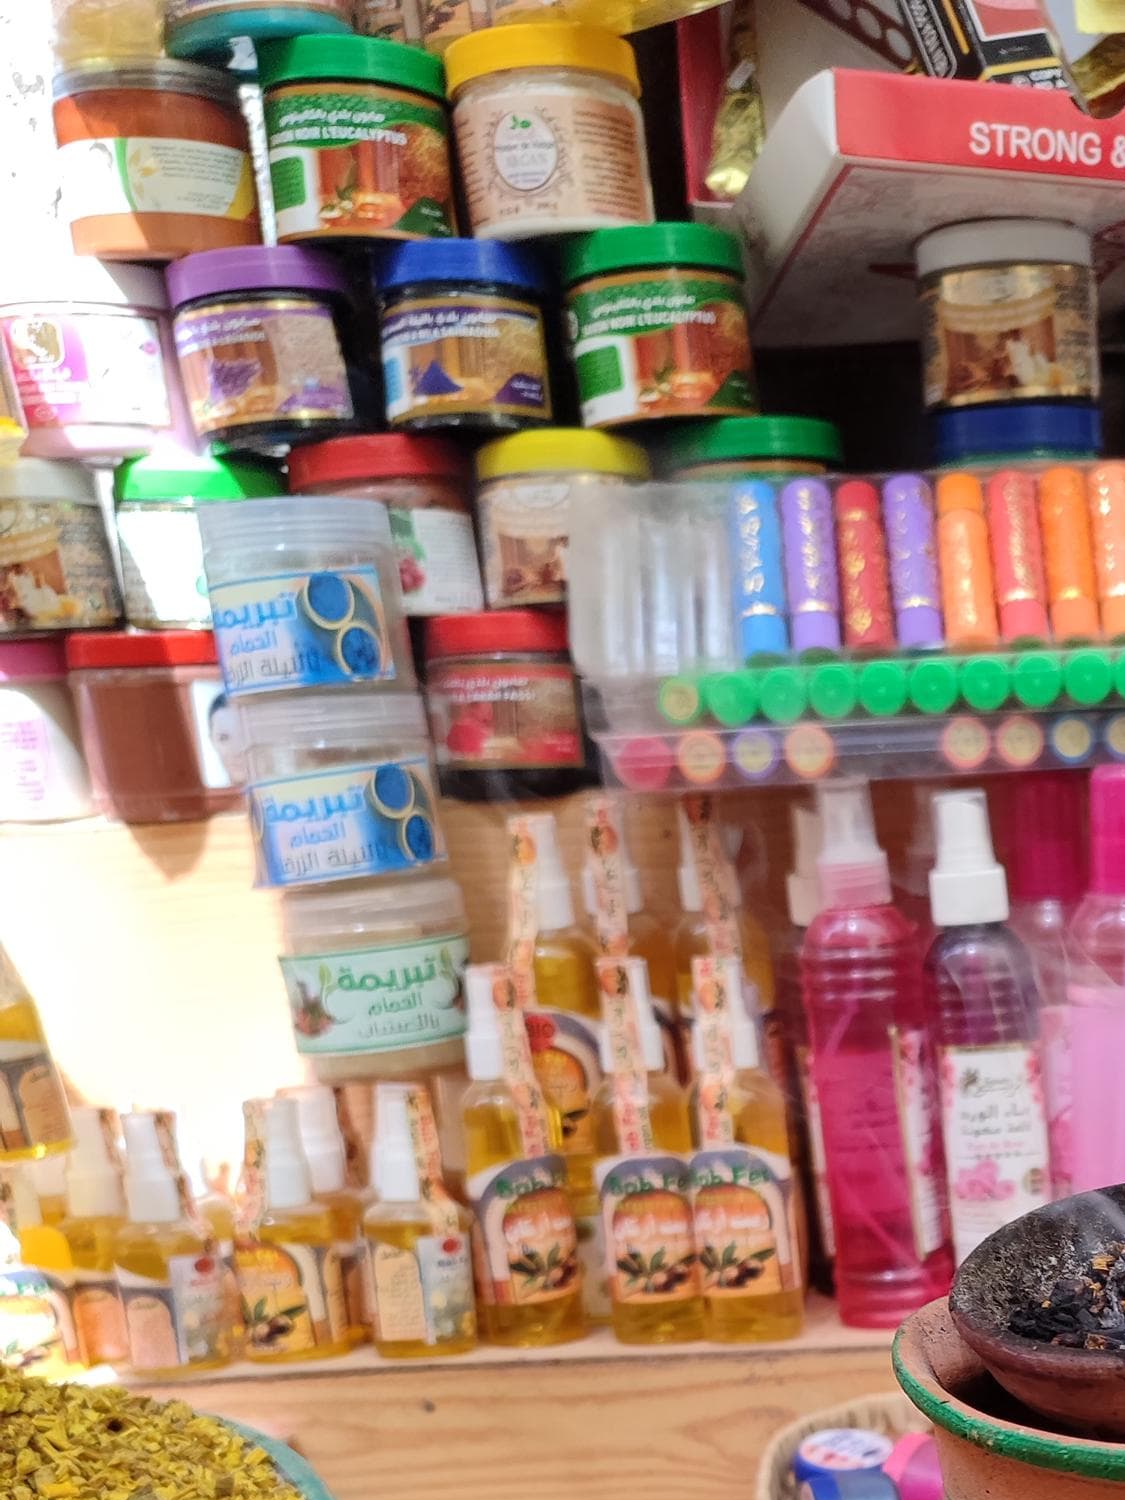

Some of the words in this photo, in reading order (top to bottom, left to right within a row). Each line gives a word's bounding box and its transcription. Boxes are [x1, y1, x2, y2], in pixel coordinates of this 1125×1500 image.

[969, 121, 1101, 166] STRONG
[230, 630, 278, 656] الحمام
[262, 783, 366, 824] تبريمة
[290, 822, 347, 850] الحمام
[337, 953, 438, 994] تبريمة
[368, 992, 423, 1017] الحمام
